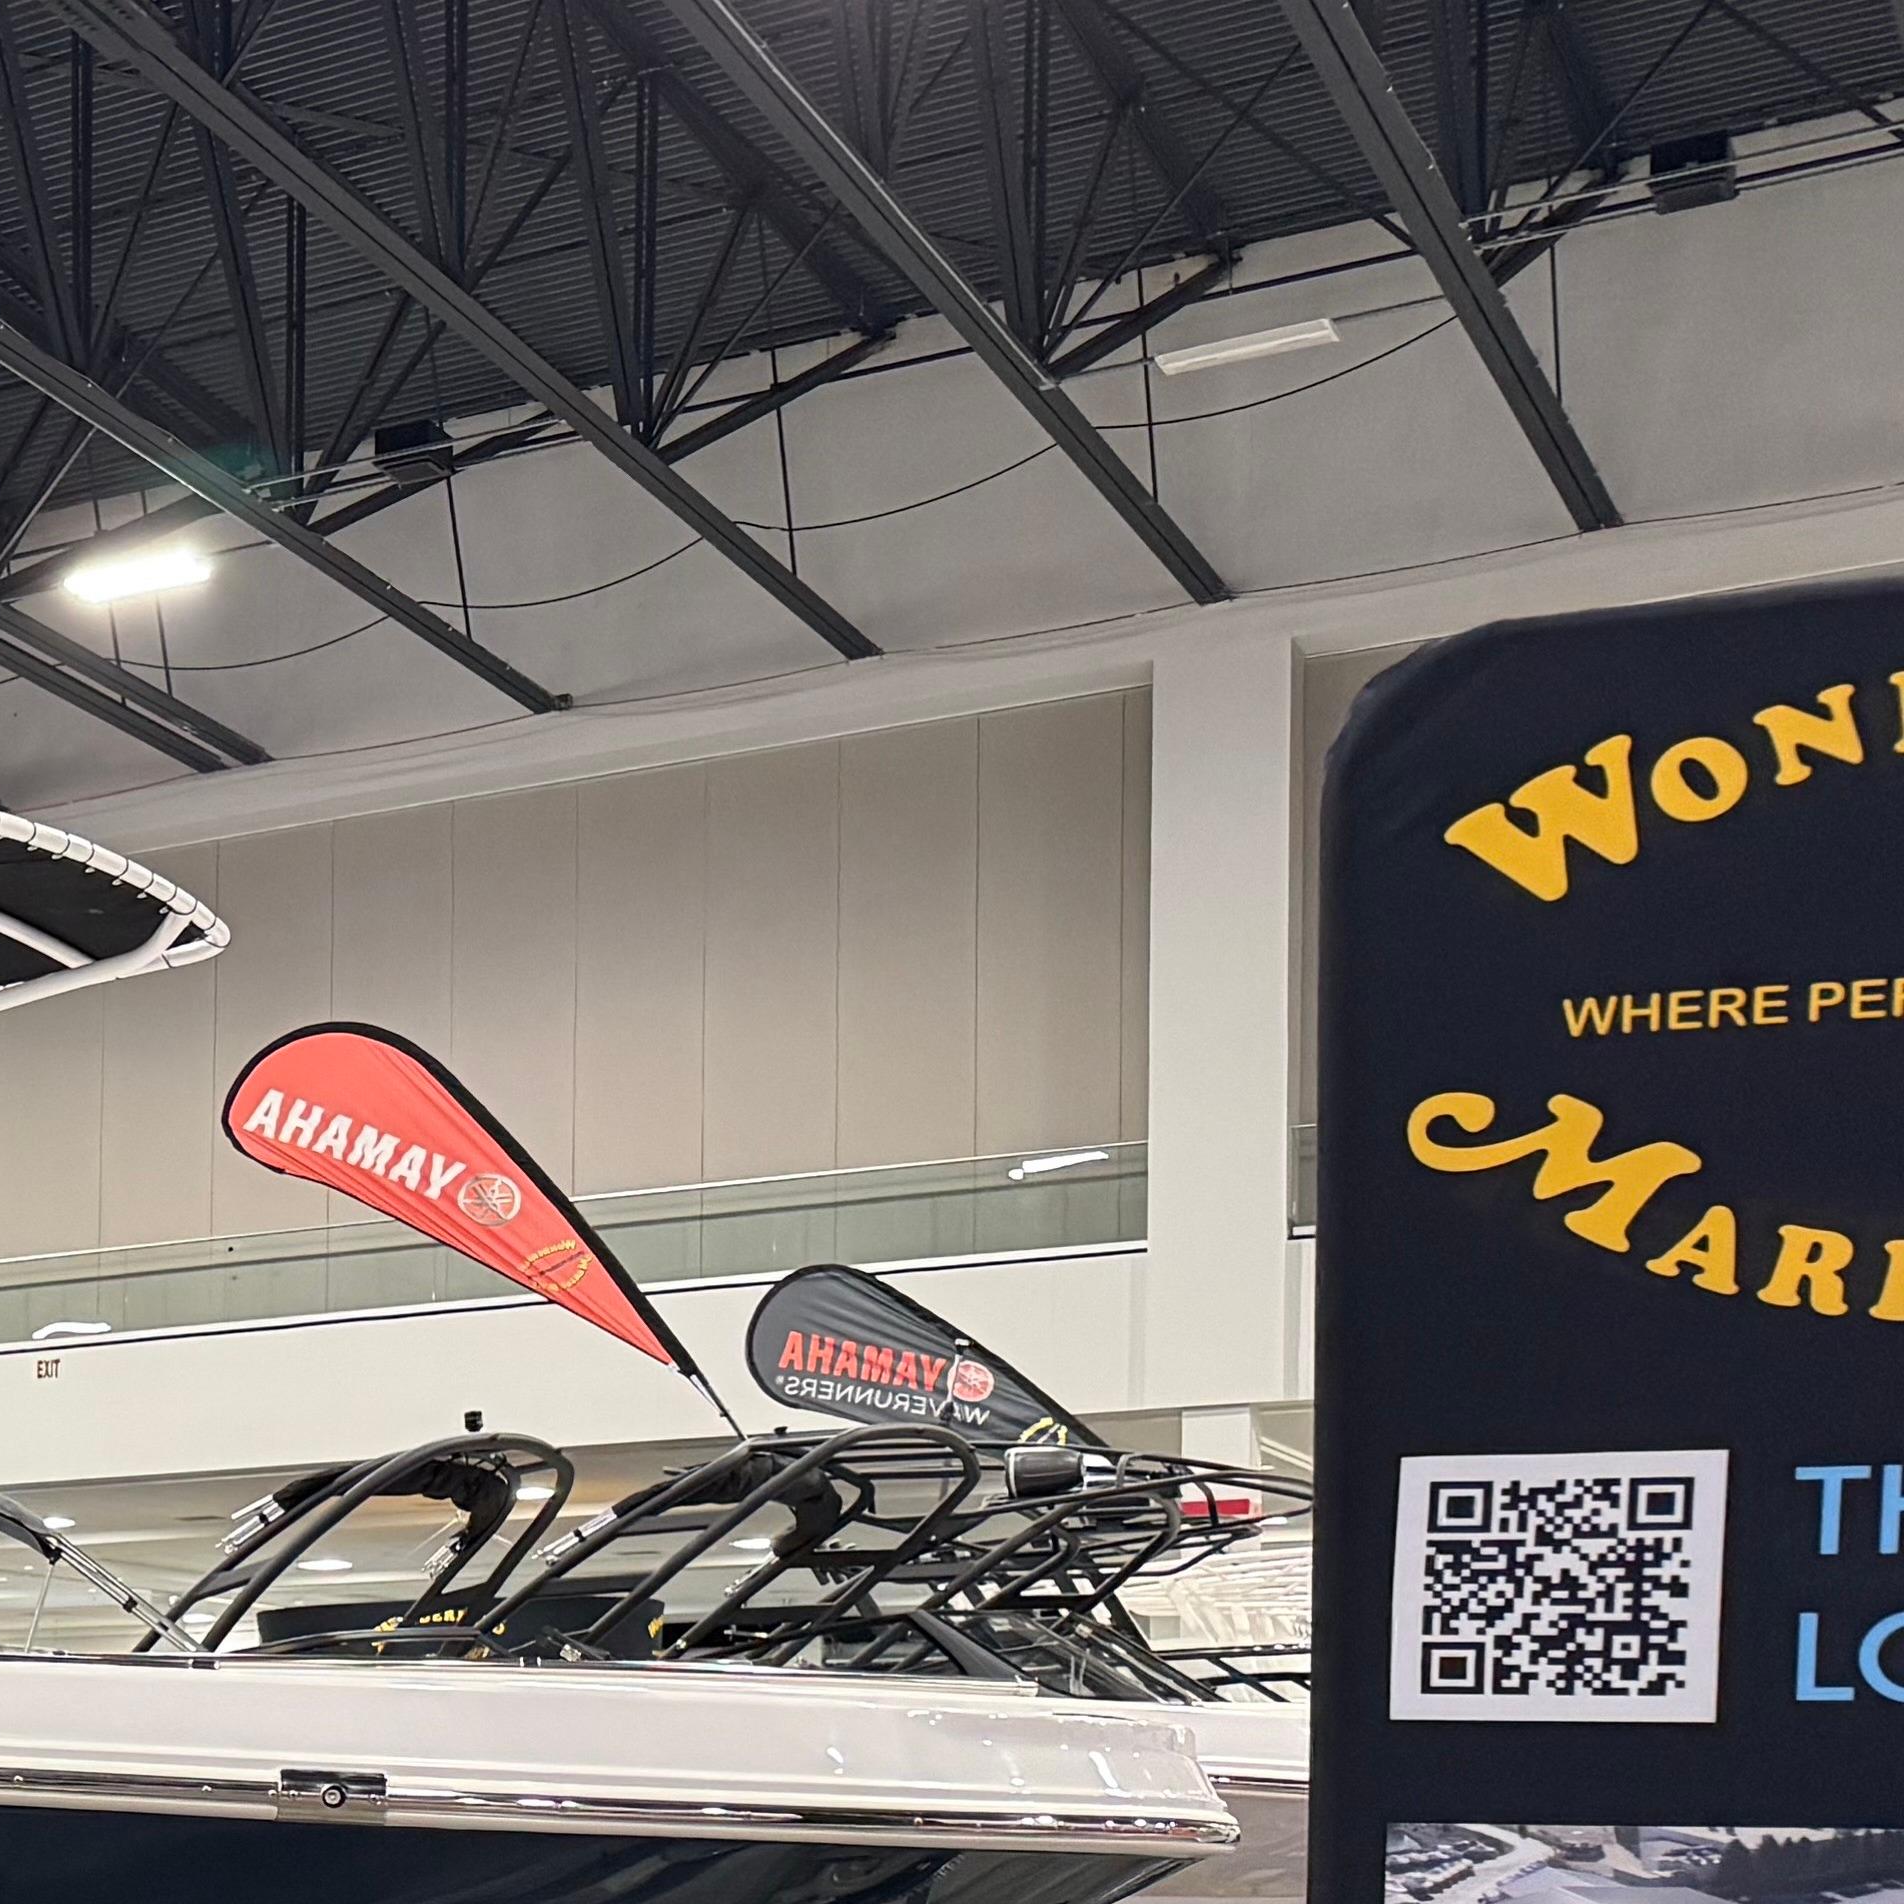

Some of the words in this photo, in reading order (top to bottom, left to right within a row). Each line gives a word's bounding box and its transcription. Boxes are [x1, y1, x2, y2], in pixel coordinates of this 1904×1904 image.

[1443, 670, 1904, 902] WON
[1563, 984, 1789, 1038] WHERE
[36, 1358, 61, 1379] EXIT
